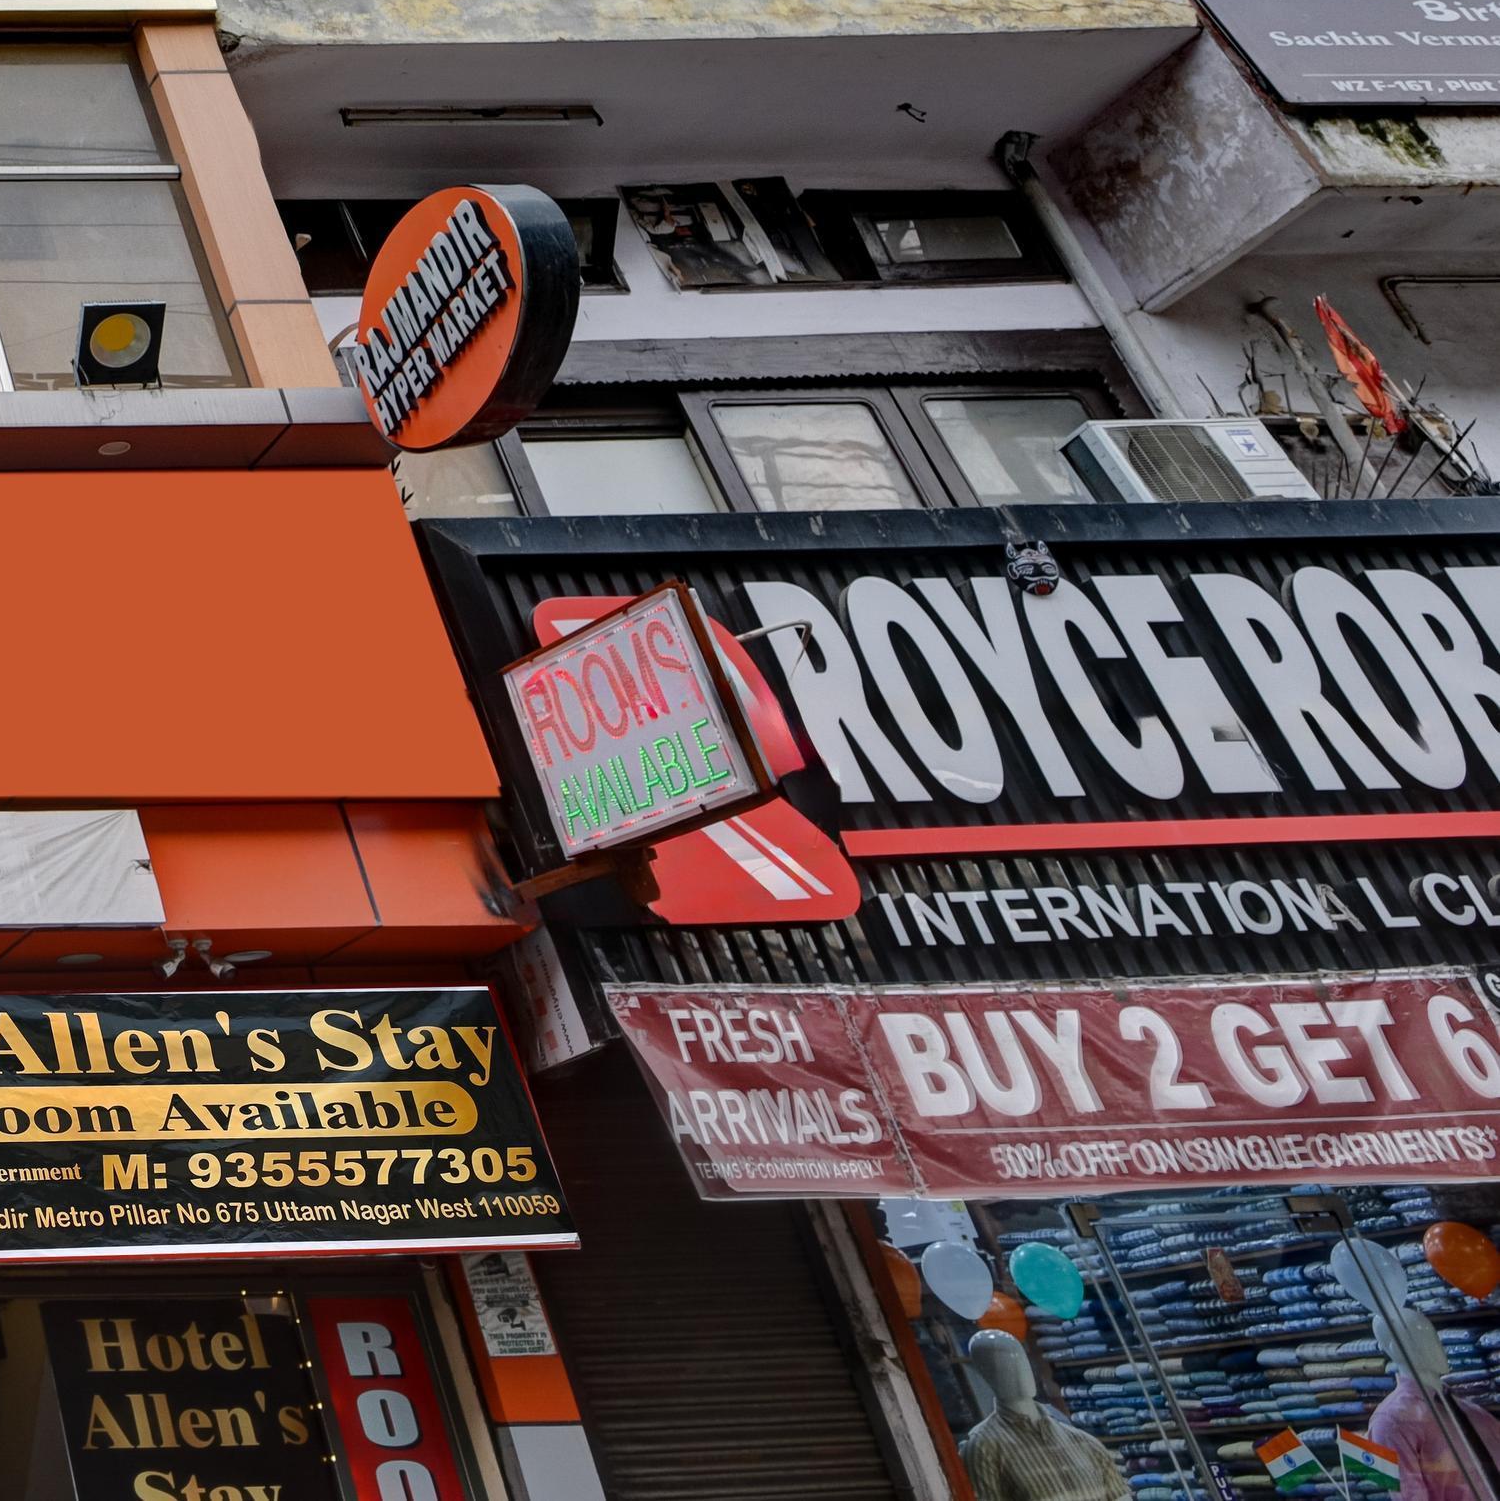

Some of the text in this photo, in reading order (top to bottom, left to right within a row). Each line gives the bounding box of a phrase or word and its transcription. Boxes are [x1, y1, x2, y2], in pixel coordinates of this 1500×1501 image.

[1268, 30, 1392, 47] Sachin
[1331, 79, 1496, 92] WZ Plot
[352, 199, 493, 398] RAJMANDIR
[373, 249, 510, 437] HYPER MARKET
[743, 574, 1283, 804] ROYCE
[560, 718, 731, 837] AVAILABLE
[309, 1009, 498, 1087] Stay
[667, 1009, 816, 1063] FRESH
[879, 1007, 1106, 1119] BUY
[1119, 1005, 1211, 1111] 2
[1210, 998, 1421, 1109] GET
[158, 1089, 458, 1134] Available
[666, 1087, 883, 1145] ARRIVALS
[189, 1146, 538, 1189] 9355577305
[35, 1205, 105, 1229] Metro
[110, 1202, 170, 1228] Pillar
[177, 1201, 211, 1224] No
[215, 1201, 259, 1223] 675
[263, 1199, 335, 1222] Uttam
[341, 1197, 412, 1226] Nagar
[416, 1195, 477, 1220] West
[478, 1193, 562, 1217] 110059
[77, 1312, 272, 1373] Hotel
[82, 1390, 311, 1450] Allen's
